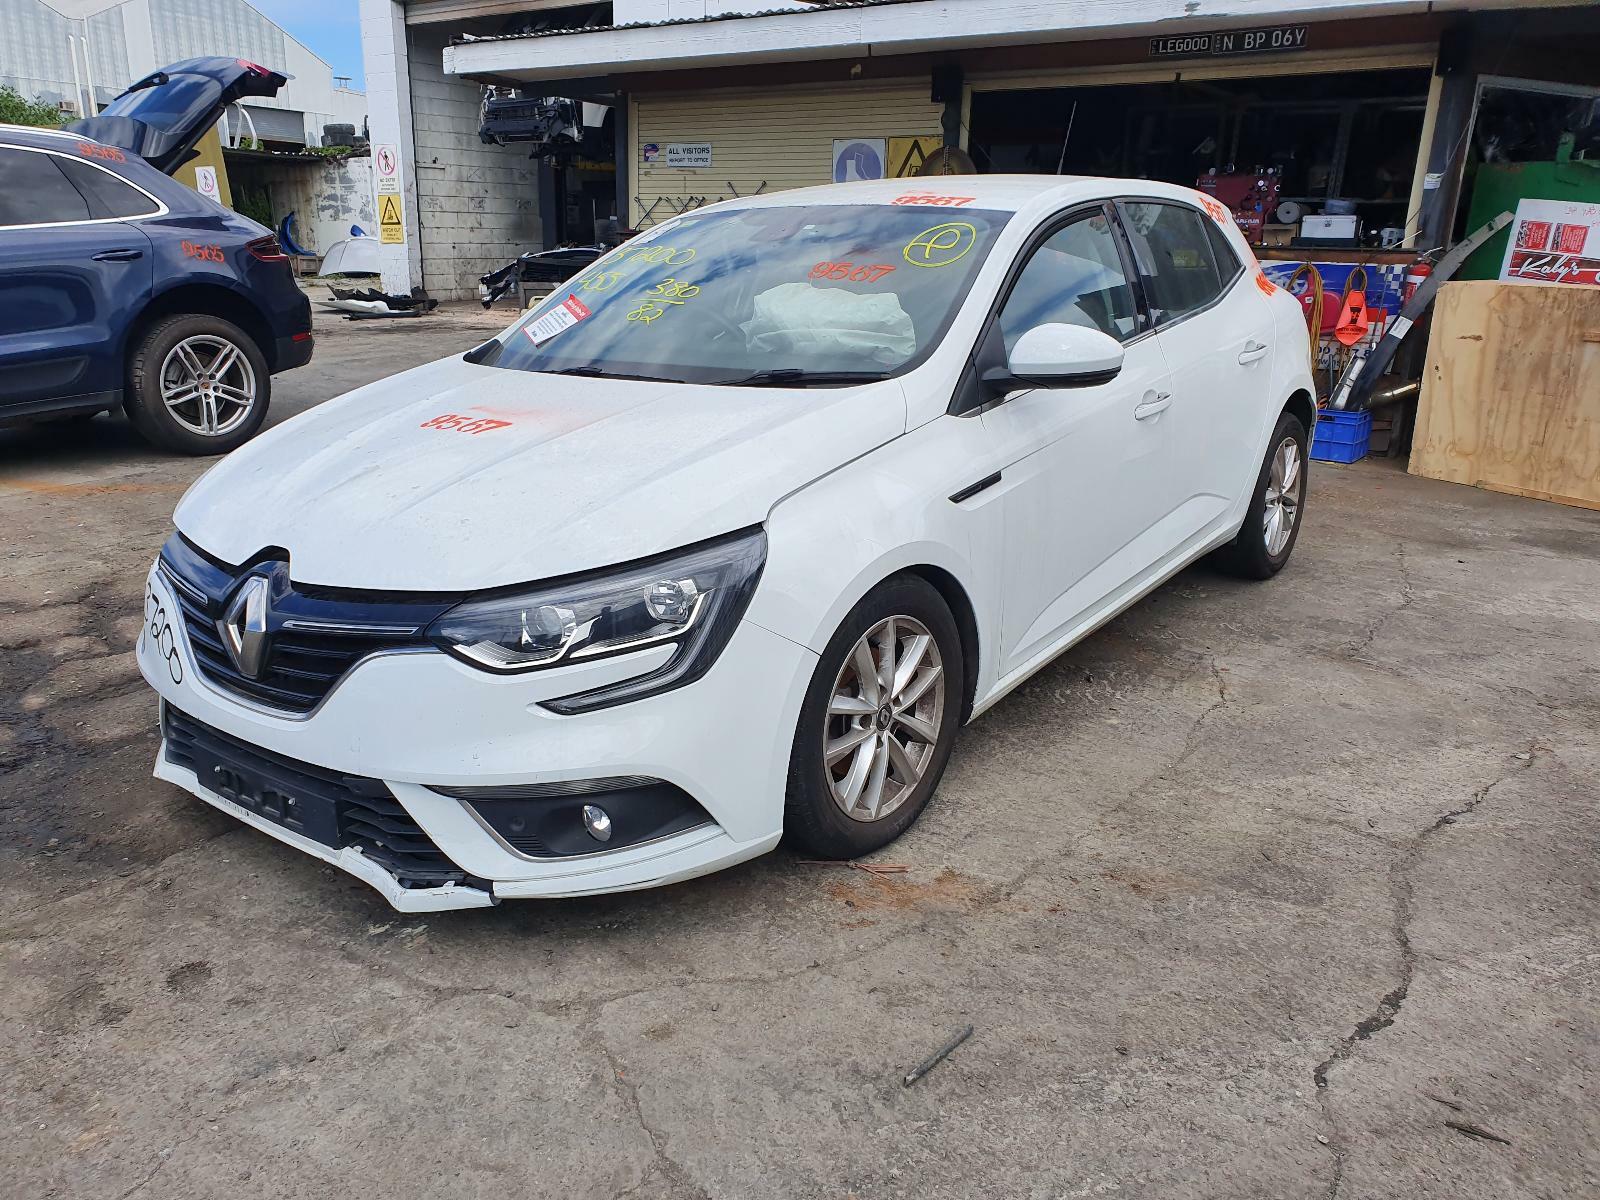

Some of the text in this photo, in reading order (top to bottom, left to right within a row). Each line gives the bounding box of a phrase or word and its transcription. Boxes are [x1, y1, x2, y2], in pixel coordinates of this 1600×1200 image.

[1244, 32, 1267, 49] BP
[668, 147, 710, 155] ALL VISITORS
[807, 261, 897, 283] 9567
[645, 278, 700, 298] 380
[420, 413, 513, 435] 9567
